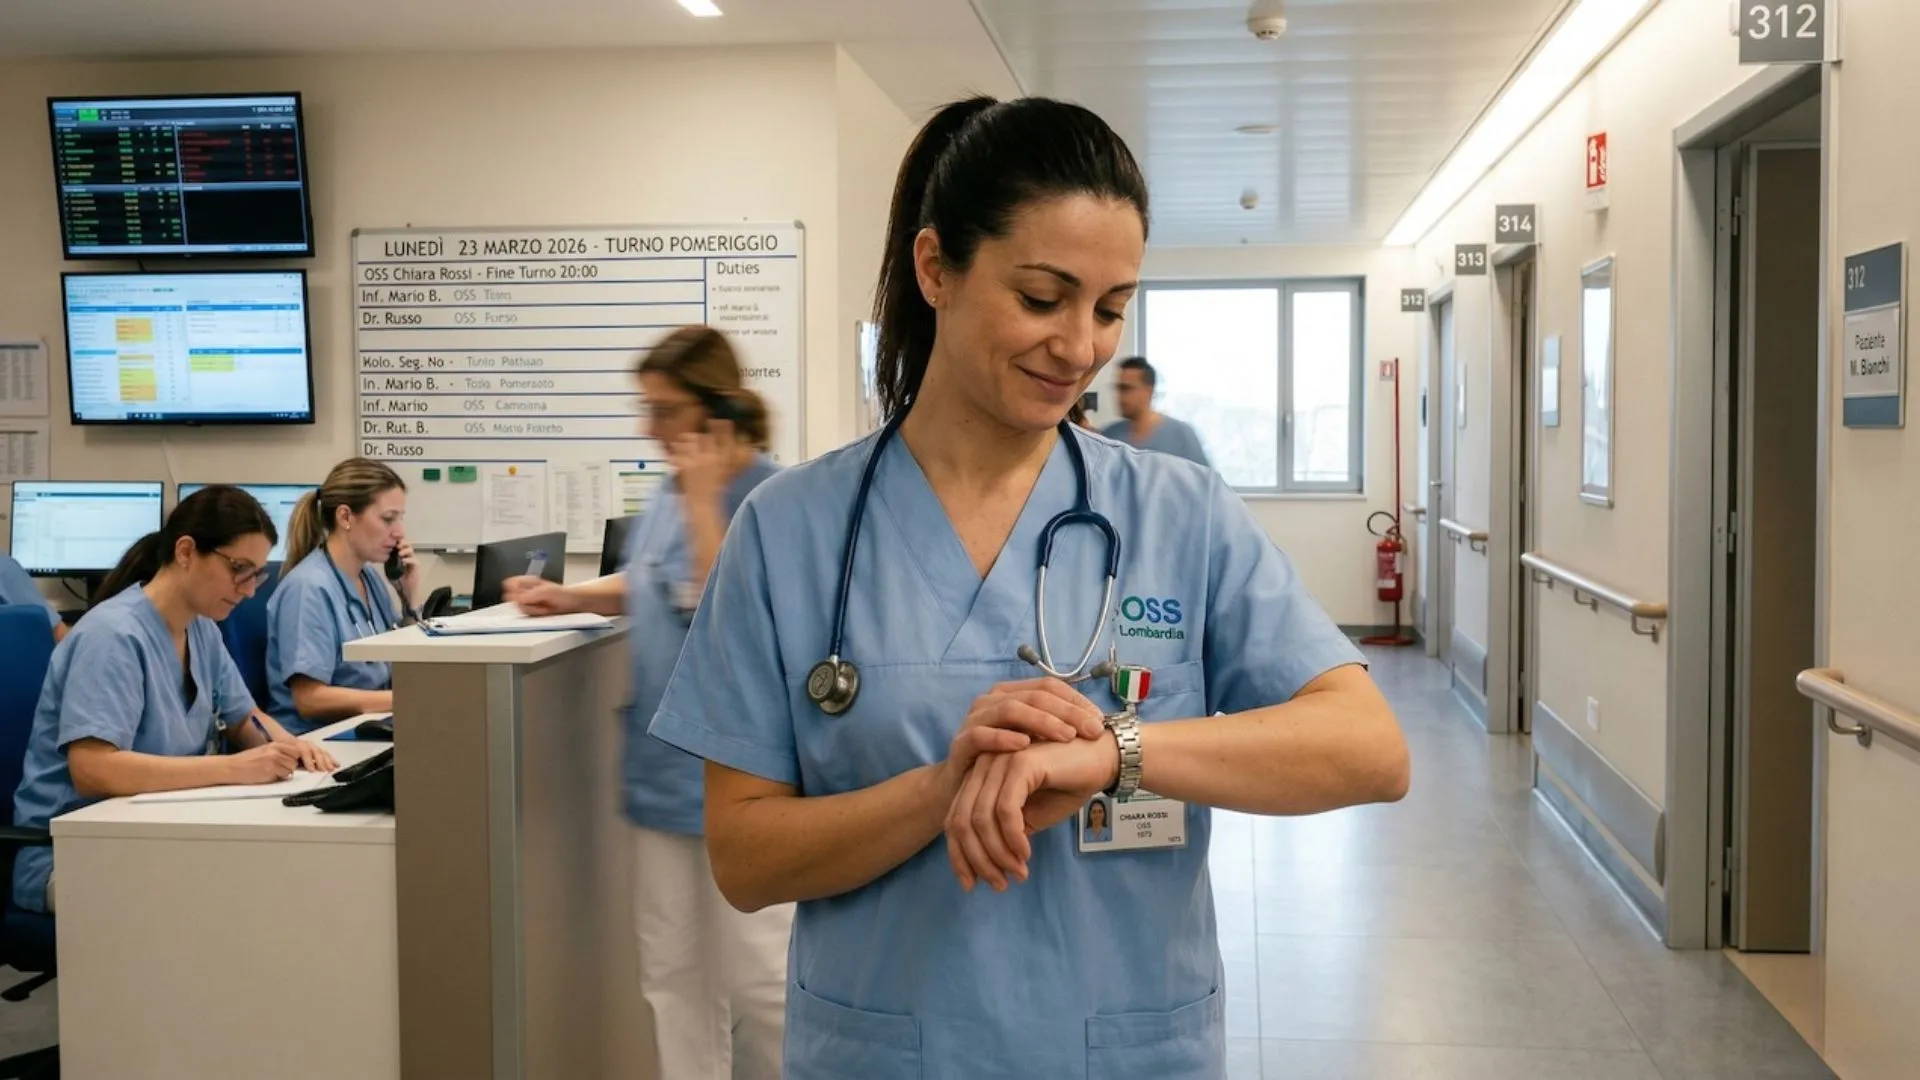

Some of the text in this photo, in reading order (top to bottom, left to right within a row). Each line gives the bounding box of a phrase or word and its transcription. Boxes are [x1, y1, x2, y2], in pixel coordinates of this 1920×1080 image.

[1748, 4, 1817, 39] 312
[1499, 215, 1532, 232] 314
[385, 236, 444, 256] LUNEDÌ
[458, 240, 478, 256] 23
[484, 239, 542, 256] MARZO
[548, 238, 588, 254] 2026
[605, 236, 664, 252] TURNO
[670, 235, 778, 252] POMERIGGIO
[1458, 252, 1484, 266] 313
[364, 268, 389, 281] OSS
[393, 266, 436, 281] Chiara
[440, 266, 472, 280] Rossi
[486, 265, 515, 280] Fine
[519, 266, 556, 279] Turno
[560, 265, 598, 279] 20:00
[716, 261, 760, 274] Duties
[1848, 265, 1866, 290] 312
[362, 290, 384, 303] Inf.
[388, 289, 425, 302] Mario
[428, 290, 441, 302] B.
[453, 288, 476, 301] OSS
[1402, 294, 1423, 306] 312
[362, 312, 380, 325] Dr.
[386, 312, 422, 325] Russo
[454, 312, 476, 324] OSS
[428, 356, 444, 368] No
[363, 378, 380, 390] In.
[385, 377, 422, 390] Mario
[426, 377, 439, 390] B.
[363, 398, 385, 412] Inf.
[463, 399, 486, 411] OSS
[364, 421, 382, 434] Dr.
[386, 421, 412, 434] Rut.
[416, 421, 429, 434] B.
[464, 422, 486, 434] OSS
[364, 442, 424, 456] Dr. Russo
[1121, 596, 1182, 624] OSS
[1119, 625, 1184, 640] Lombardia
